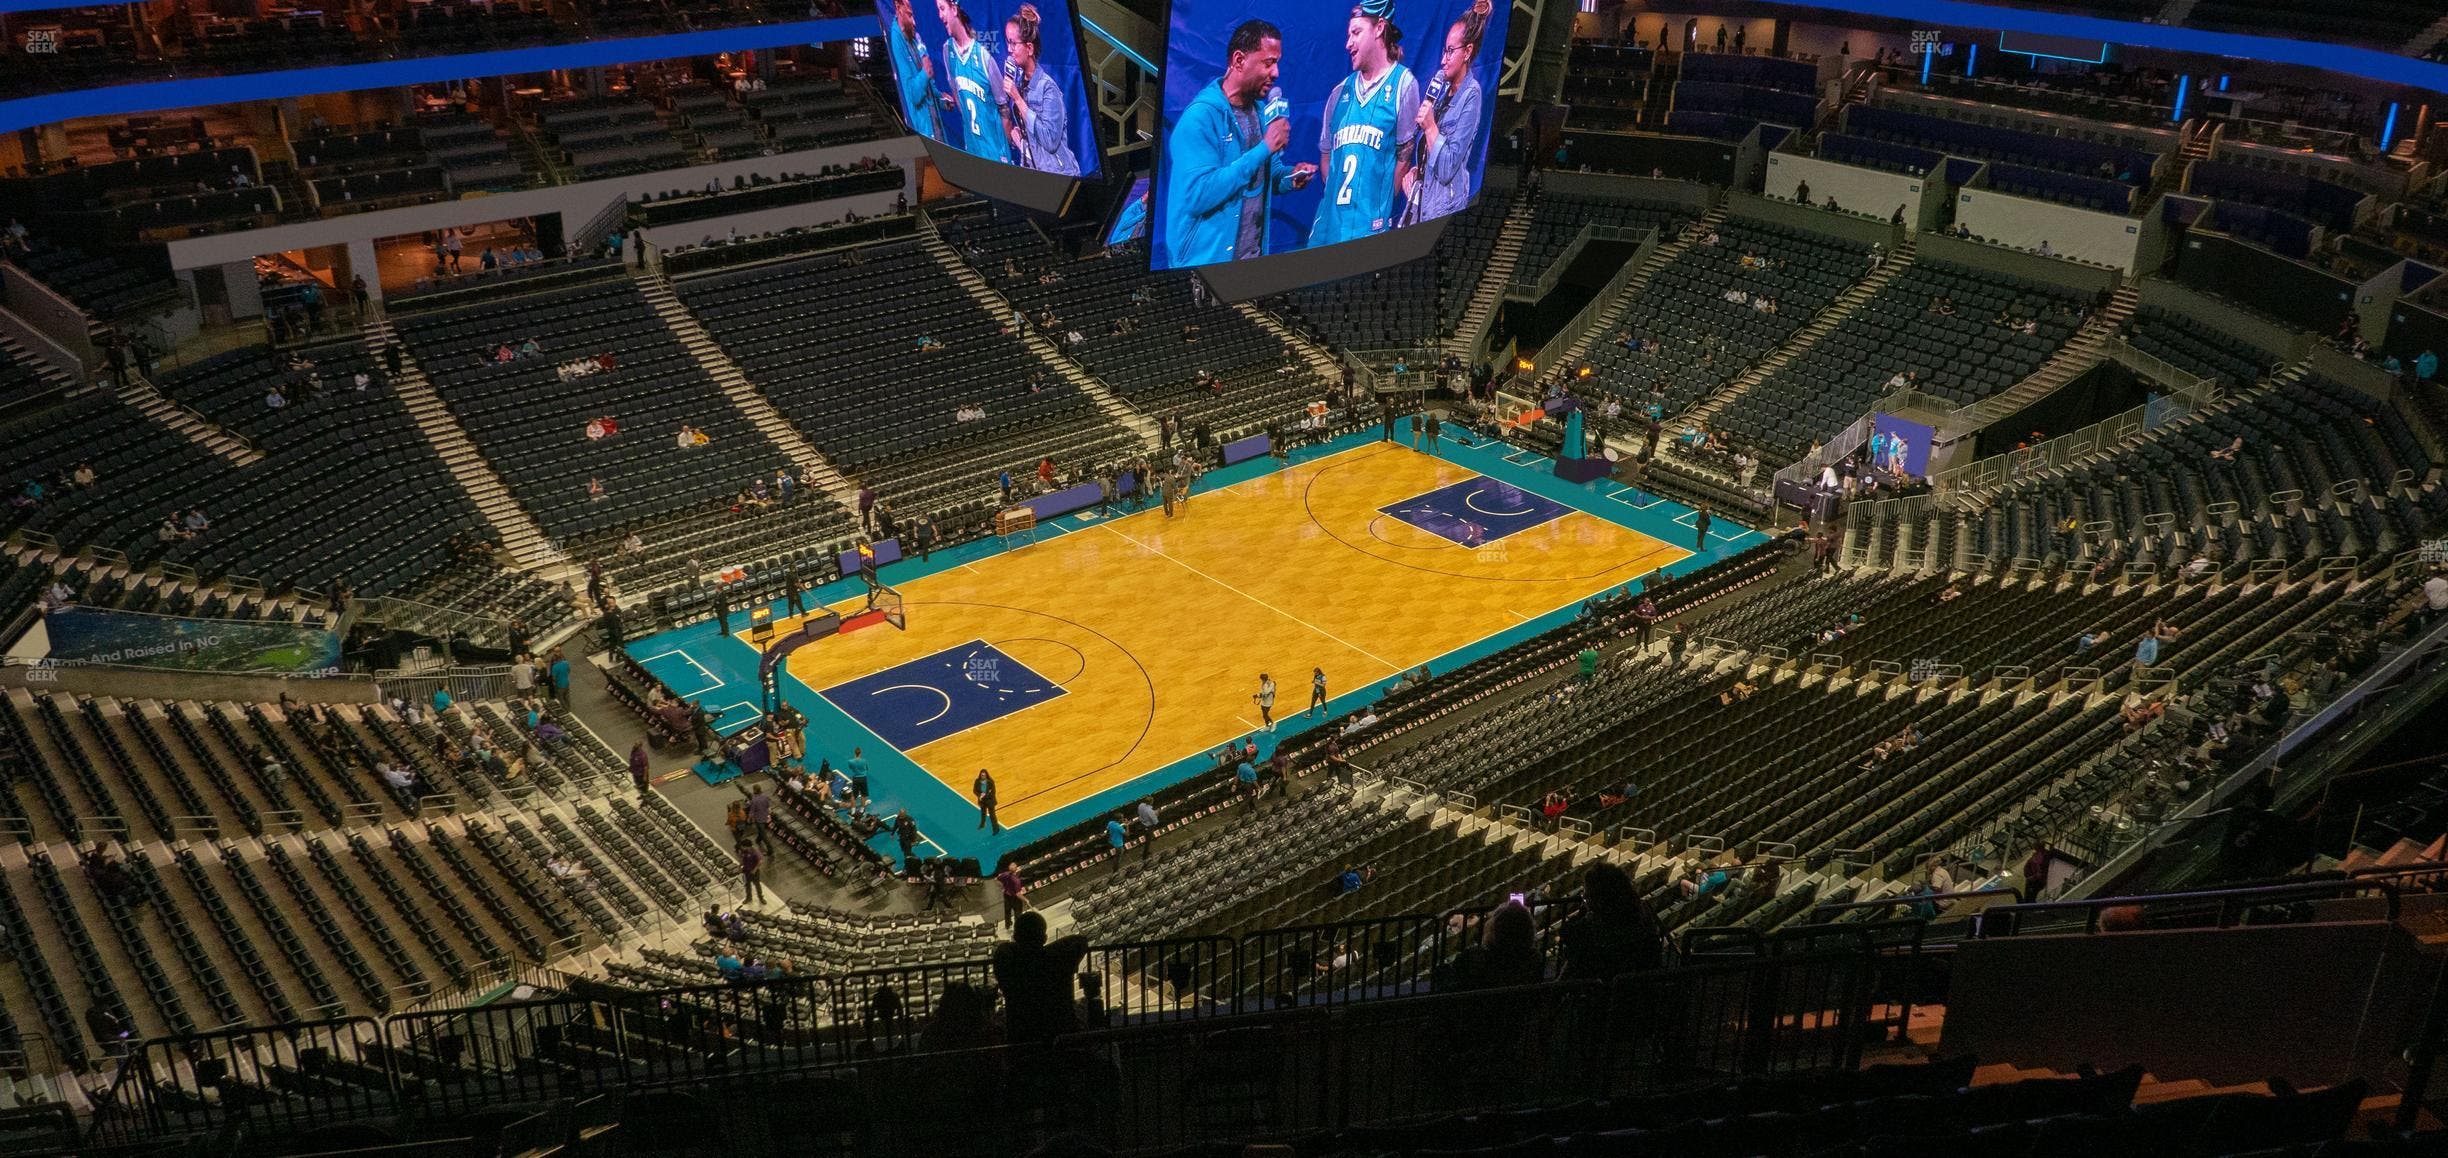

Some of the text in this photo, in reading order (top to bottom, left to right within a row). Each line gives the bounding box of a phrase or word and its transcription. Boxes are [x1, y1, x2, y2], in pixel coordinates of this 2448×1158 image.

[966, 98, 981, 136] 2
[1336, 154, 1357, 205] 2
[816, 577, 825, 585] G
[829, 573, 837, 581] G
[804, 581, 812, 589] G
[754, 596, 762, 604] G
[767, 592, 775, 600] G
[728, 604, 736, 612] G
[742, 601, 750, 609] G
[675, 620, 683, 628] G
[90, 650, 121, 663] And
[125, 643, 175, 659] Raised
[179, 640, 193, 651] In
